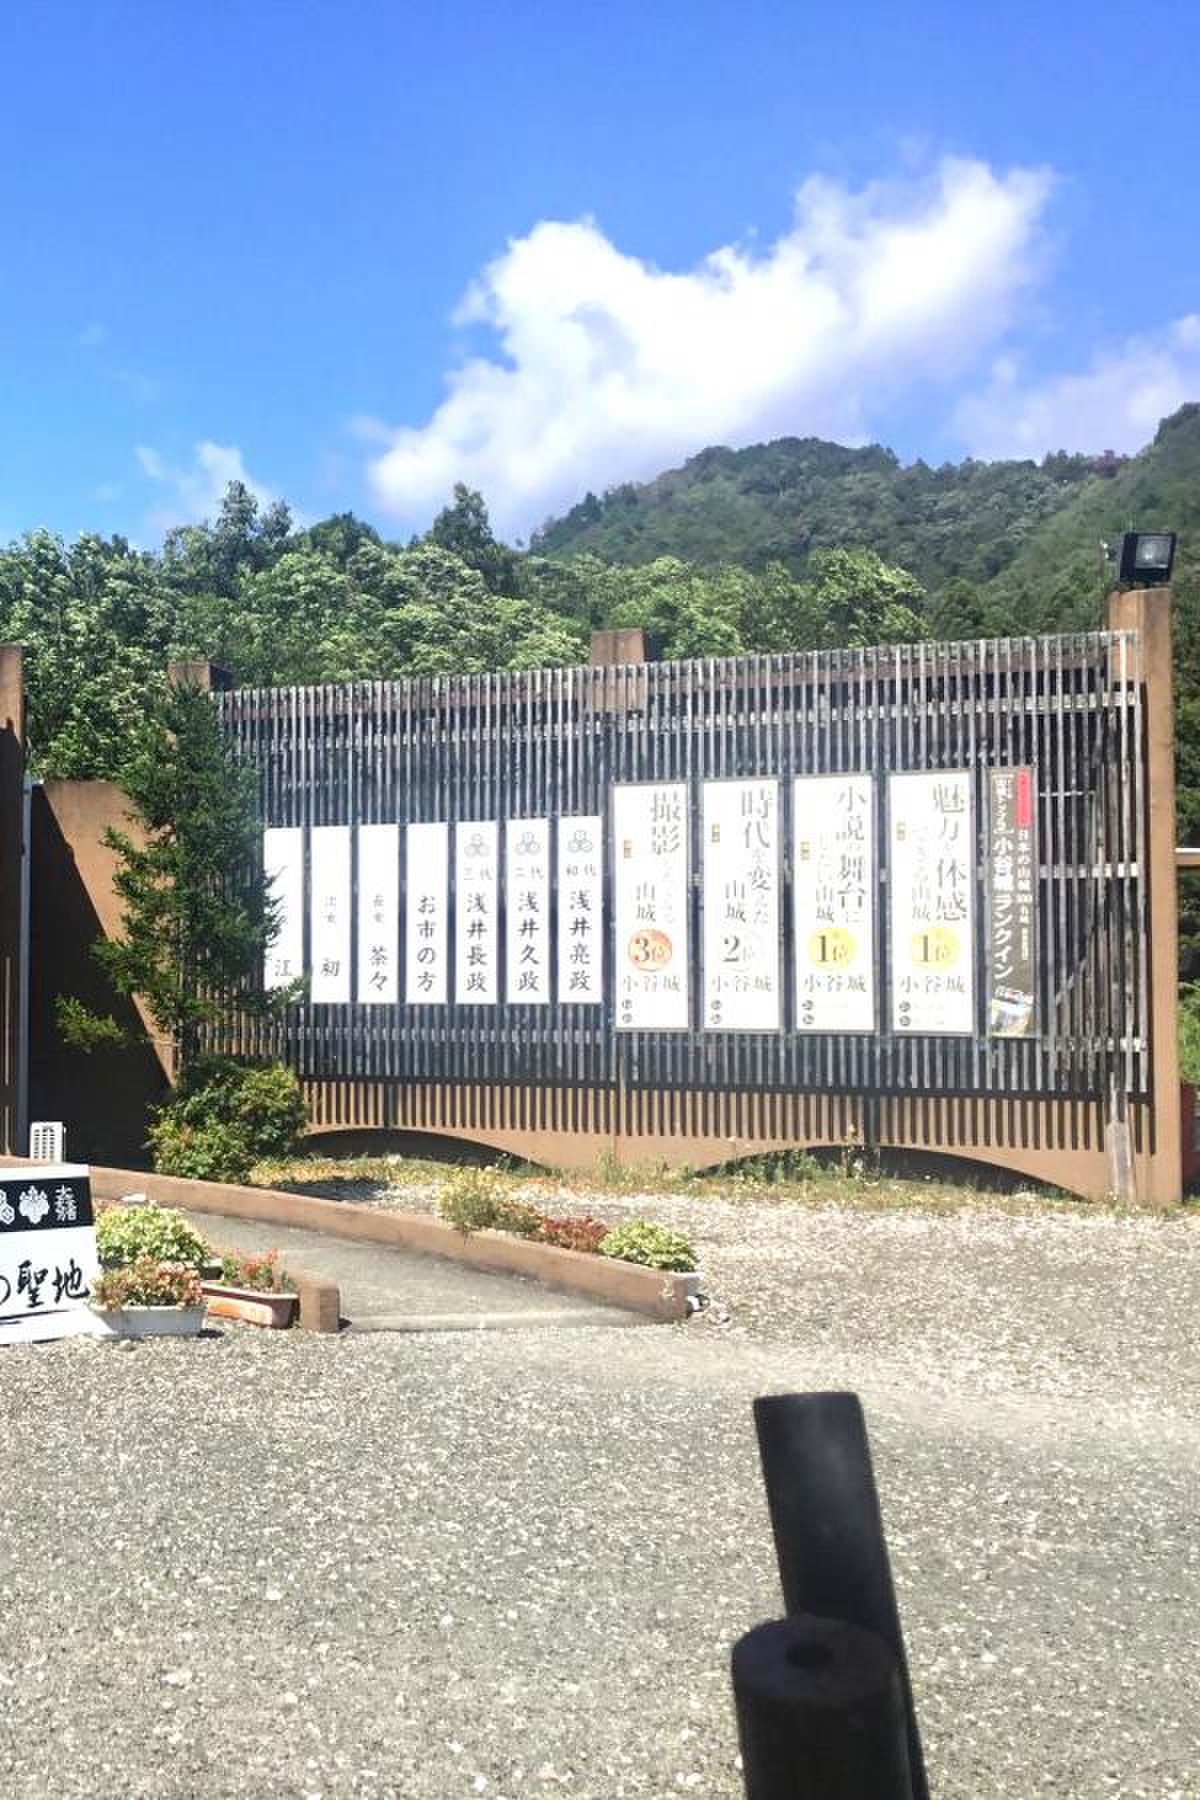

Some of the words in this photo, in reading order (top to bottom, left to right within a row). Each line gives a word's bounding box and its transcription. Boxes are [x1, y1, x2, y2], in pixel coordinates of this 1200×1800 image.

[464, 867, 493, 881] 三代
[515, 865, 544, 880] 二代
[636, 883, 657, 922] 山城
[724, 881, 747, 923] 山城
[417, 895, 437, 992] お市の方
[466, 892, 489, 993] 浅井長政
[518, 890, 540, 991] 浅井久政
[569, 889, 592, 991] 浅井亮政
[274, 959, 291, 976] 江
[320, 957, 340, 977] 初
[369, 944, 388, 991] 茶々
[622, 975, 681, 993] 小谷城
[711, 975, 772, 993] 小谷城
[803, 975, 867, 993] 小谷城
[899, 975, 966, 993] 小谷城
